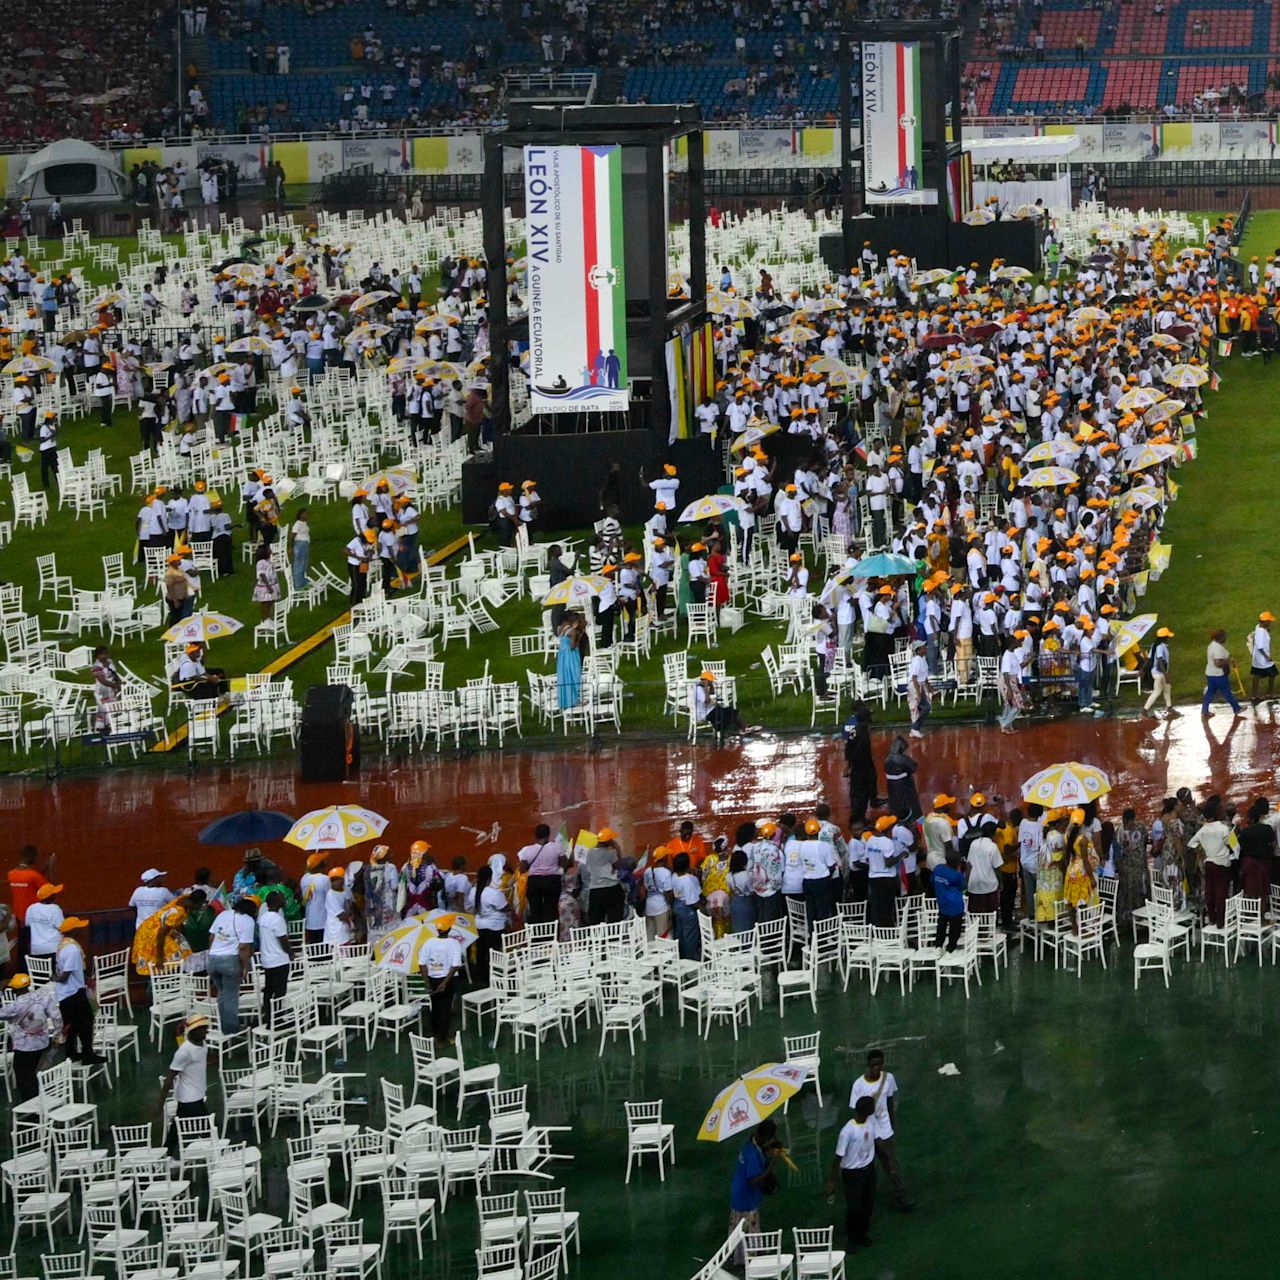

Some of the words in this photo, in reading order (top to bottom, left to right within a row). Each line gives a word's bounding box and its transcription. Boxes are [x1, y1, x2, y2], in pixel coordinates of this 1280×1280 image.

[864, 44, 879, 83] LEÓN
[865, 89, 877, 113] XIV
[528, 150, 553, 214] LEÓN
[555, 212, 561, 221] DE
[555, 222, 561, 231] SU
[530, 224, 549, 263] XIV
[532, 274, 542, 314] GUINEA
[533, 316, 543, 380] ECUATORIAL
